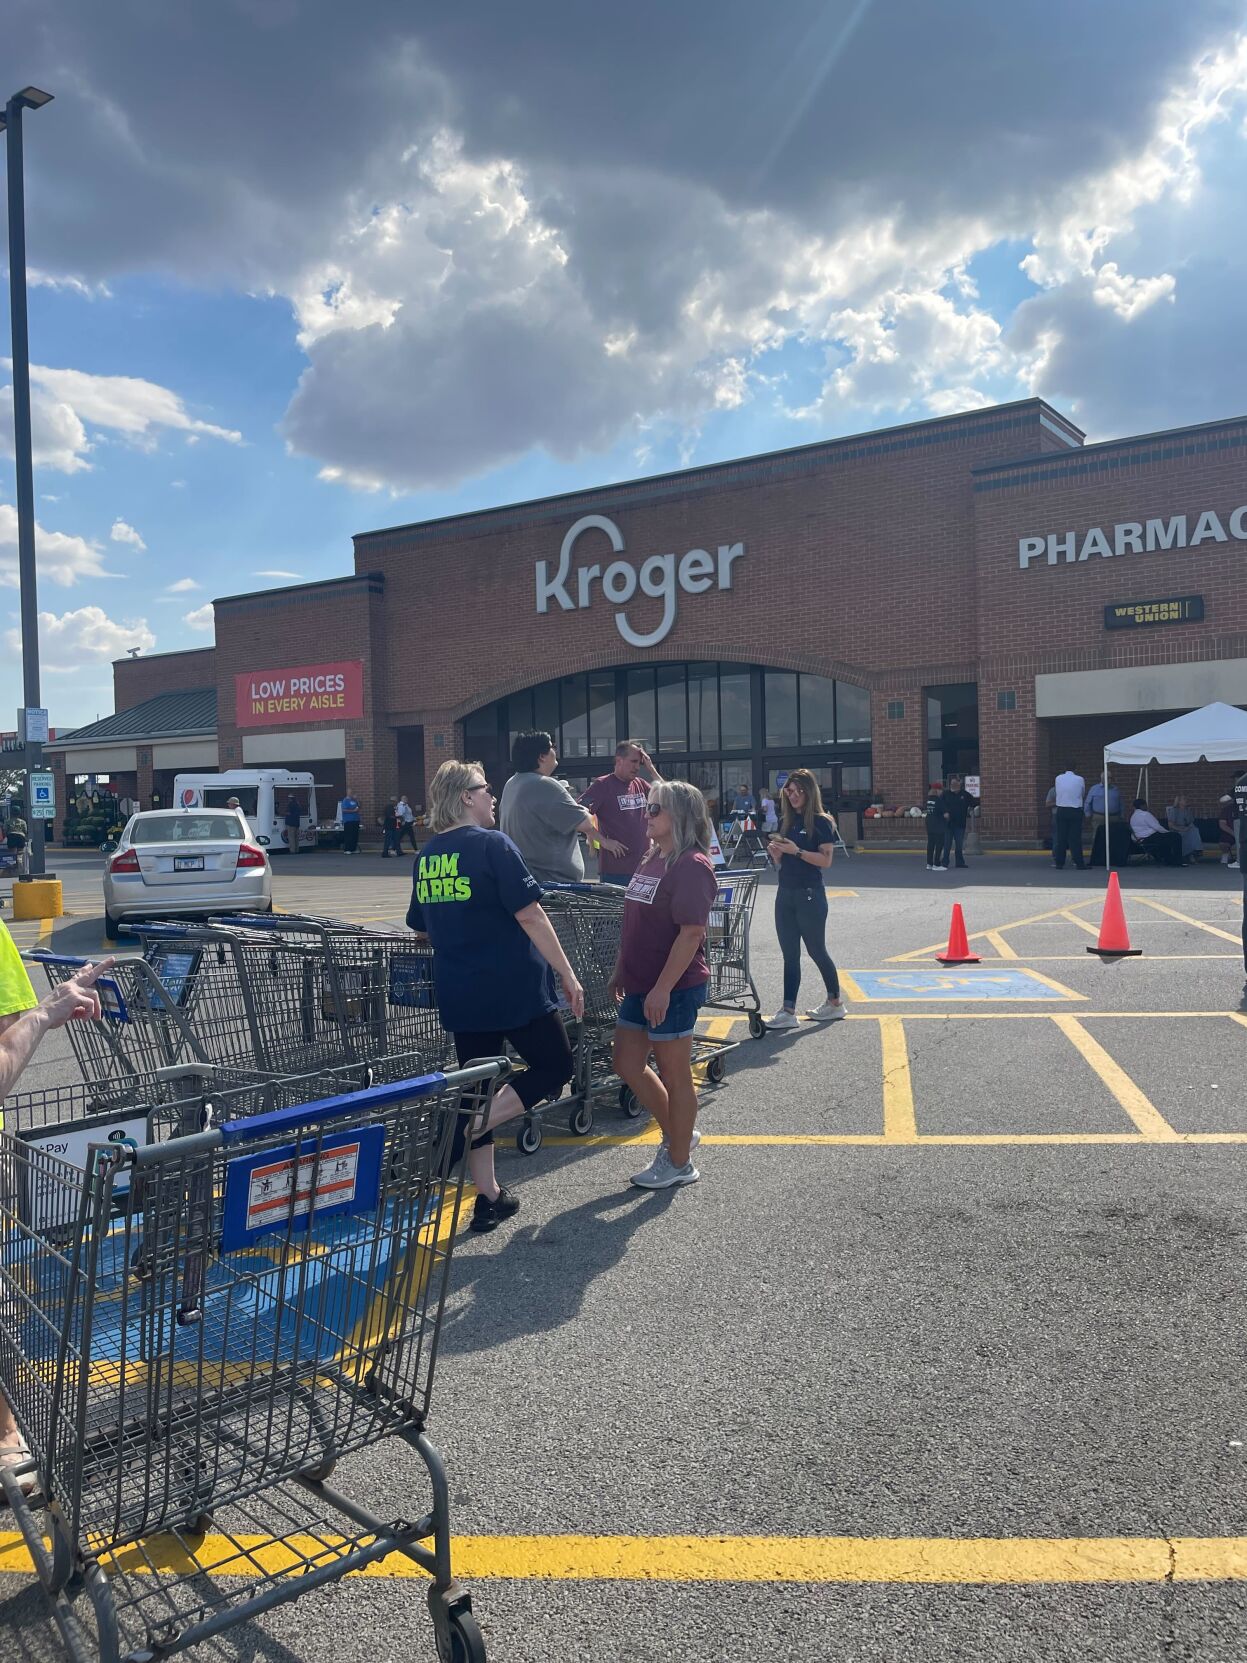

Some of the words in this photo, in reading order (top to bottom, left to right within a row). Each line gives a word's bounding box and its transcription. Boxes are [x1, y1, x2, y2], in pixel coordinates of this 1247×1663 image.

[535, 514, 744, 648] Kroger
[1114, 602, 1179, 617] WESTERN
[1134, 610, 1179, 623] UNION
[251, 680, 286, 699] LOW
[290, 674, 345, 695] PRICES
[252, 701, 264, 714] IN
[268, 697, 306, 713] EVERY
[309, 693, 345, 709] AISLE
[418, 852, 460, 880] ADM
[46, 1142, 69, 1154] Pay
